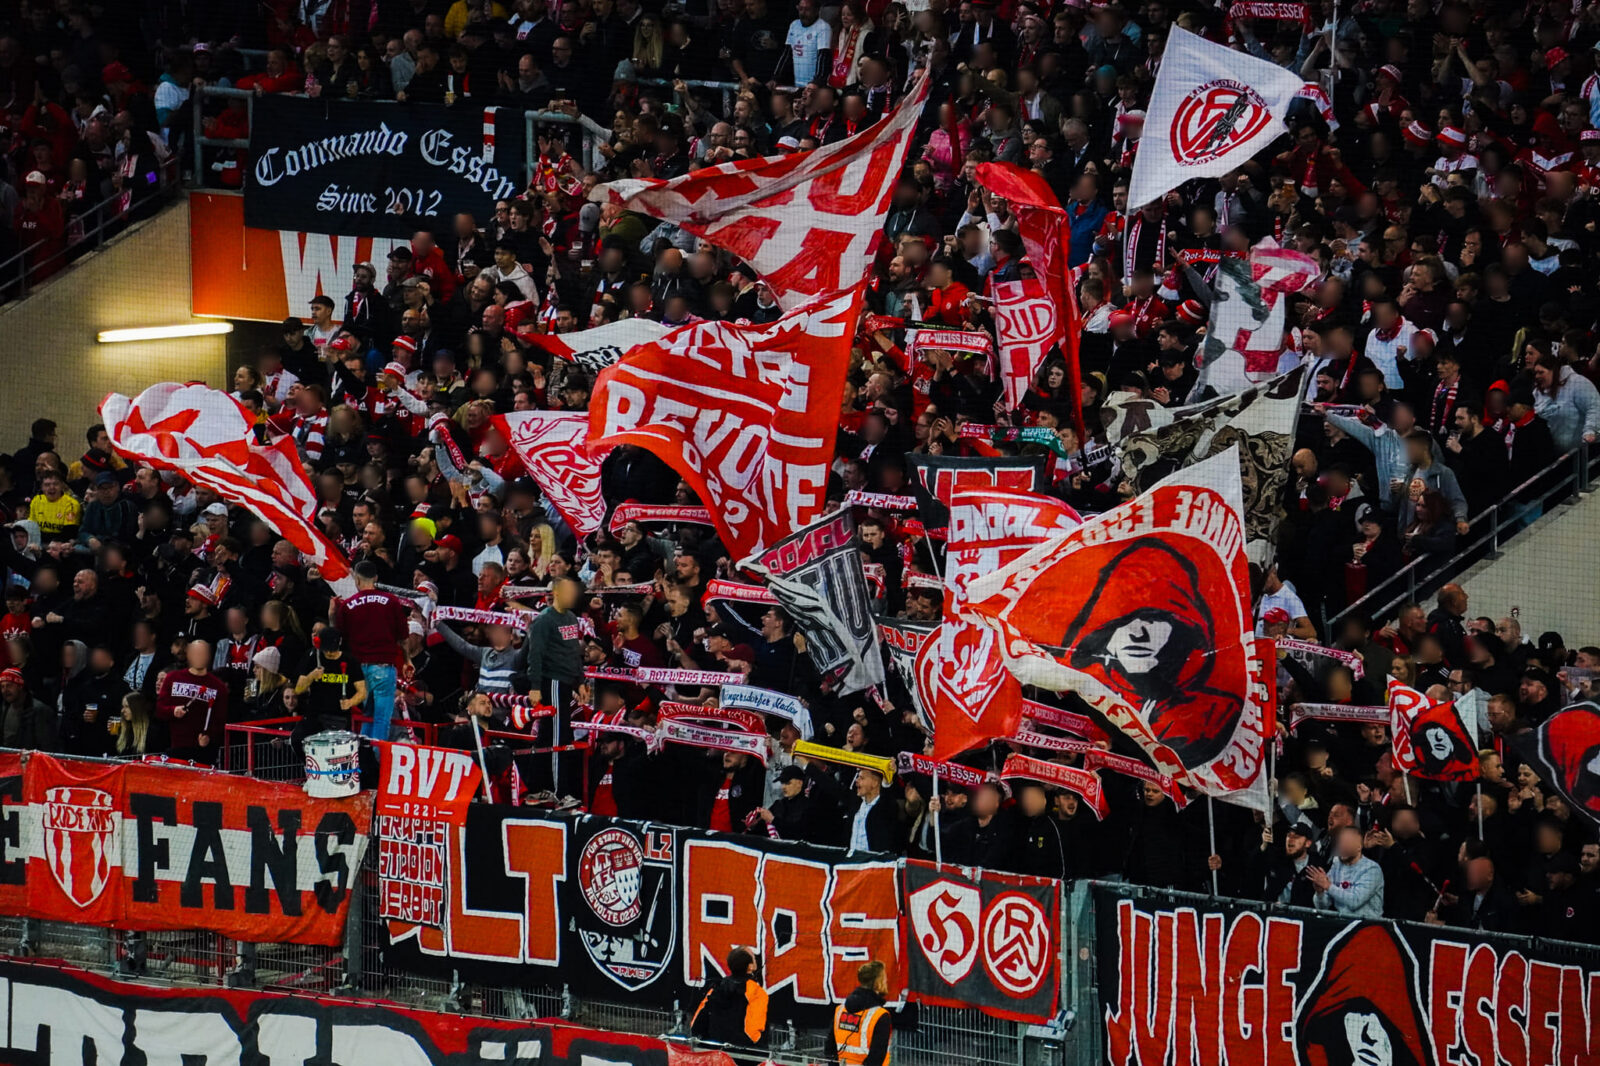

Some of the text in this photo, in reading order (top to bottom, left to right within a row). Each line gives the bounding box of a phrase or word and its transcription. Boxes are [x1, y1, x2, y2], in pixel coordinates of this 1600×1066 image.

[255, 121, 516, 200] Commando Essen
[316, 183, 443, 217] Since 2012
[387, 744, 474, 801] RVT
[950, 767, 983, 784] ESSEN
[129, 793, 357, 917] FANS
[386, 818, 902, 1005] LTRAS
[1105, 900, 1600, 1066] JUNGE ESSEN
